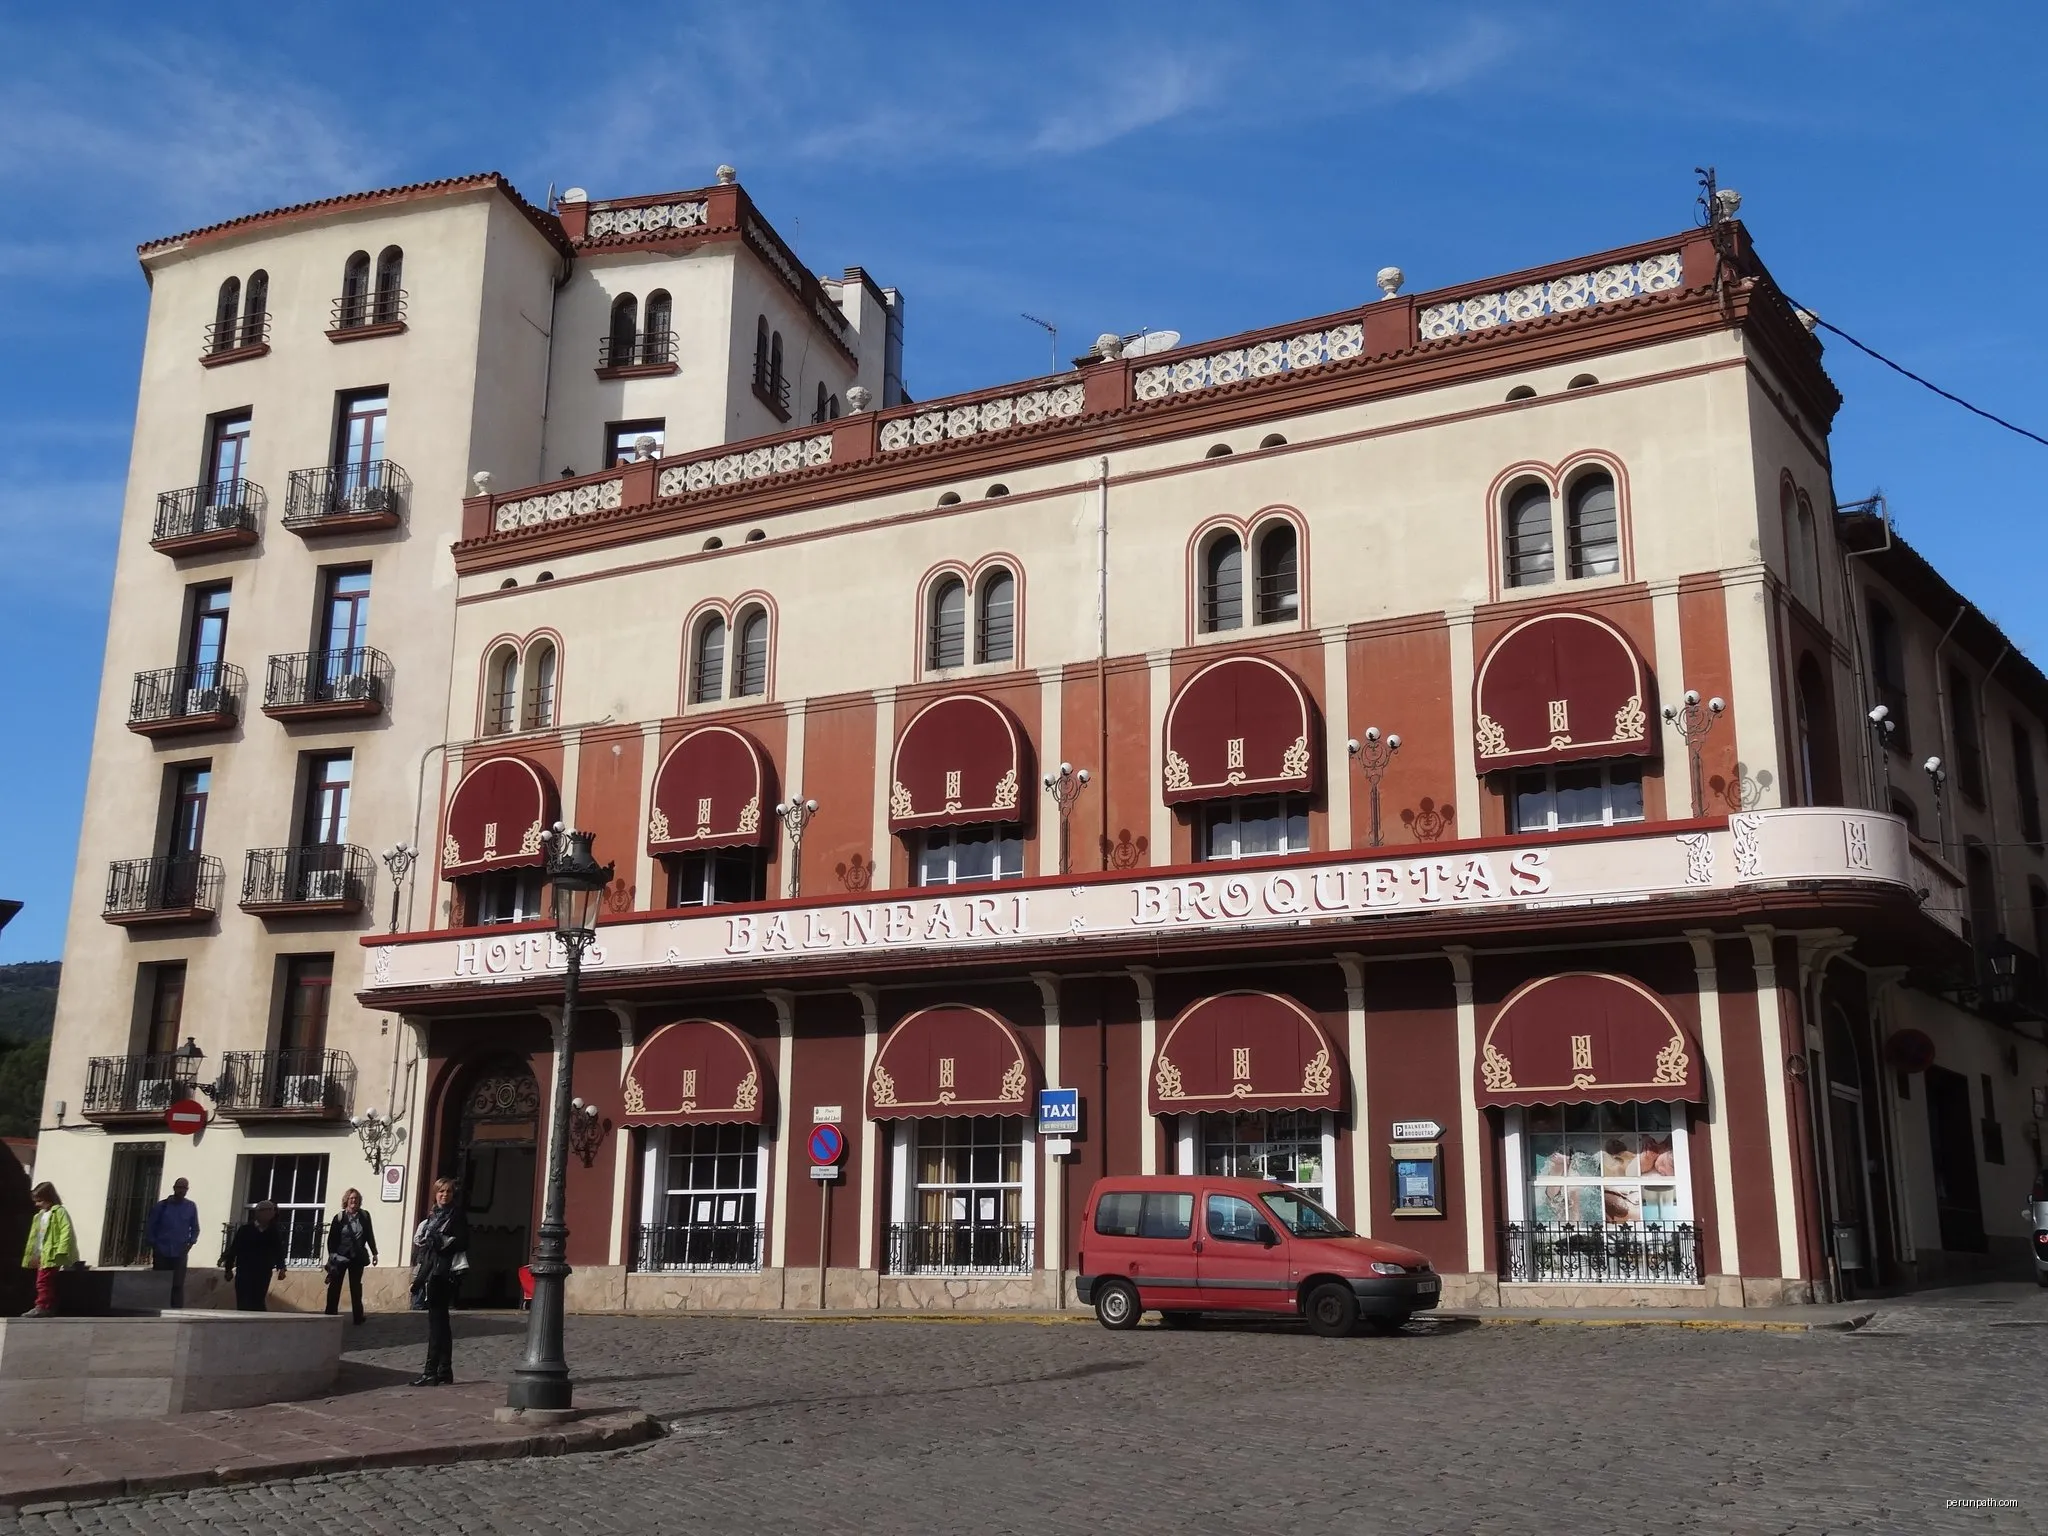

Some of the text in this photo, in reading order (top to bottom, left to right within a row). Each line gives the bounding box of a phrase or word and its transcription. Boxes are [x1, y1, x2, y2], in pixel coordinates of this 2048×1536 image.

[455, 848, 1551, 976] HOTEL BALNEARI BROQUETAS
[1041, 1104, 1076, 1117] TAXI
